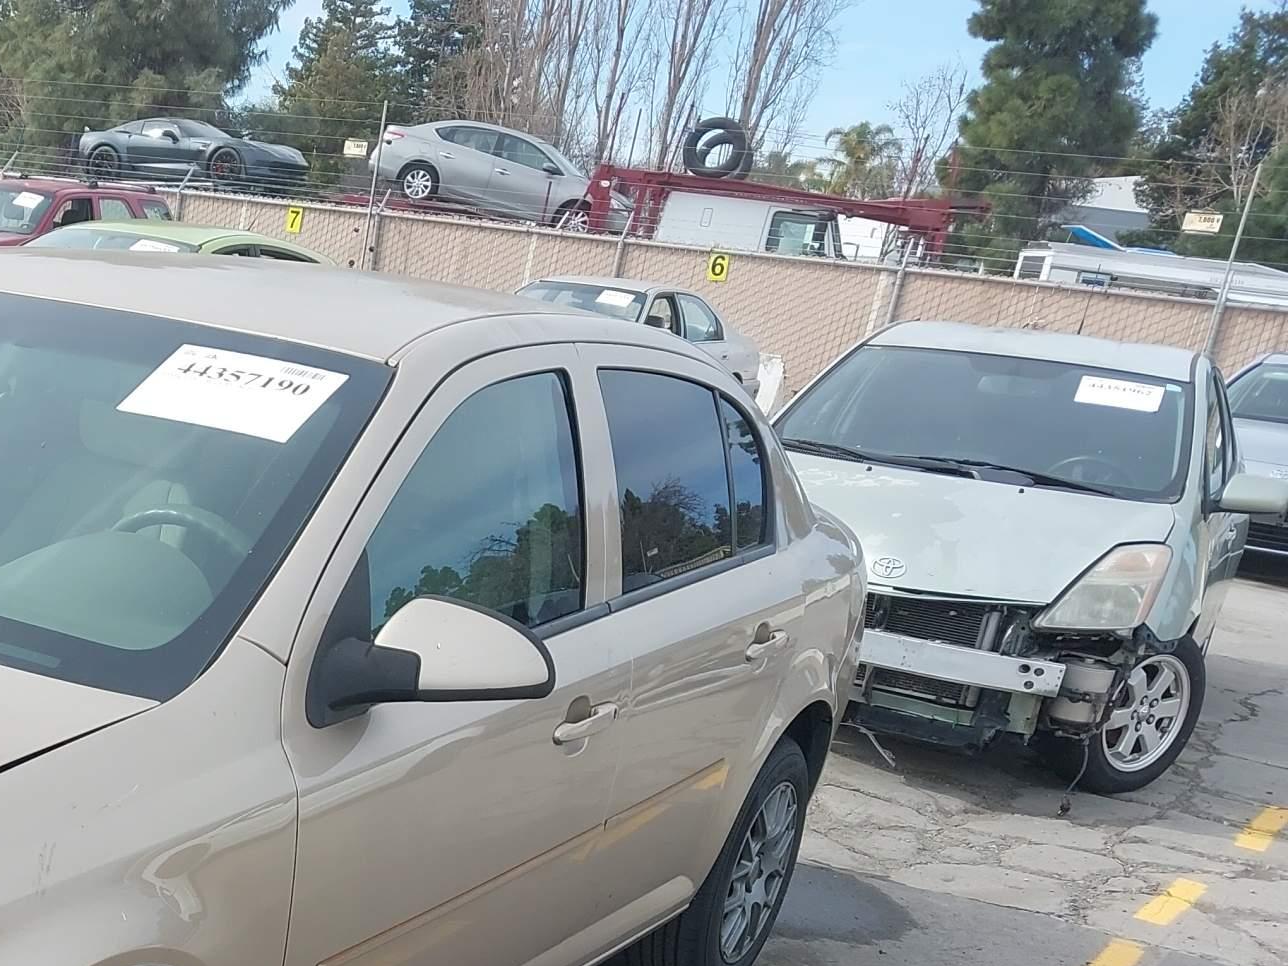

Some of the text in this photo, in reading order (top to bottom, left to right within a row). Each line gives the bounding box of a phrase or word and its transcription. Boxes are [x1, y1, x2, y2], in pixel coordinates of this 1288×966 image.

[290, 210, 301, 228] 7
[711, 255, 726, 276] 6
[177, 362, 312, 396] 44357190
